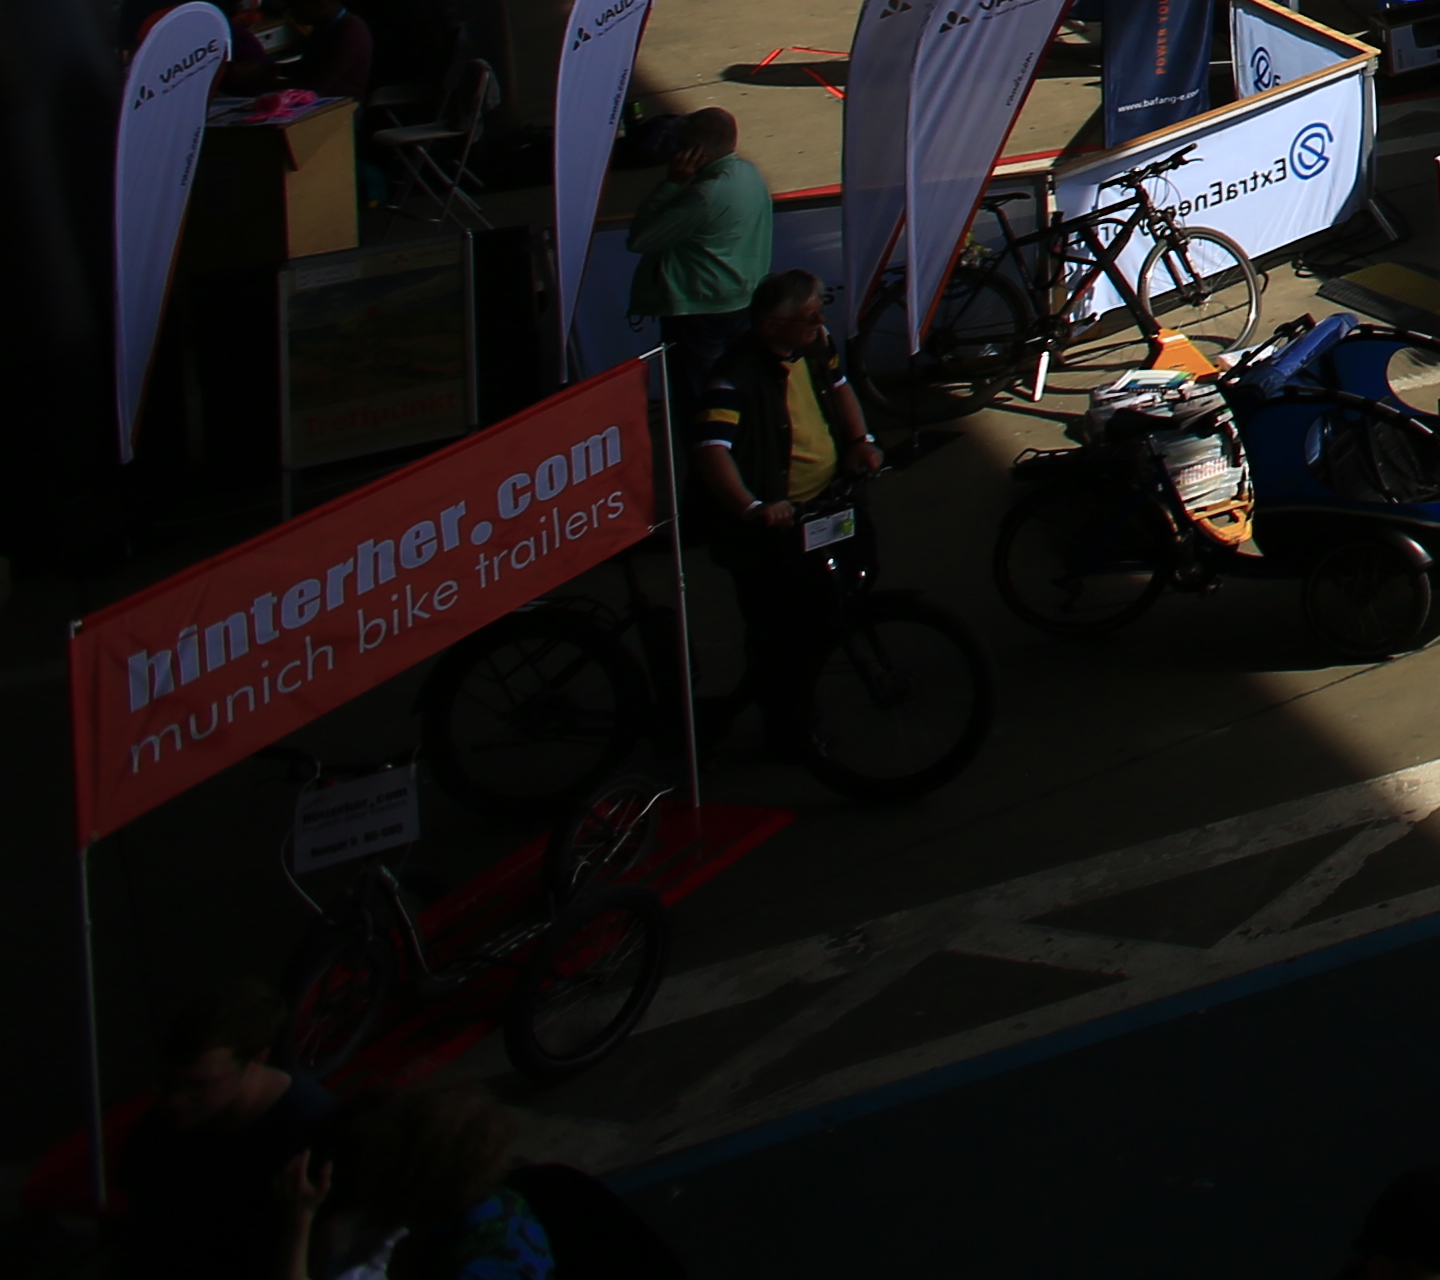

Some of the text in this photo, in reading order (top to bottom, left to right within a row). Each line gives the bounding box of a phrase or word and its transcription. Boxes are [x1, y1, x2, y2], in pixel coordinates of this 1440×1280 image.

[159, 39, 220, 83] VAUDE
[1155, 24, 1168, 75] POWER
[303, 389, 459, 436] Treffpunkt
[126, 423, 623, 713] hinterher.com
[128, 486, 626, 776] munich bike trailers
